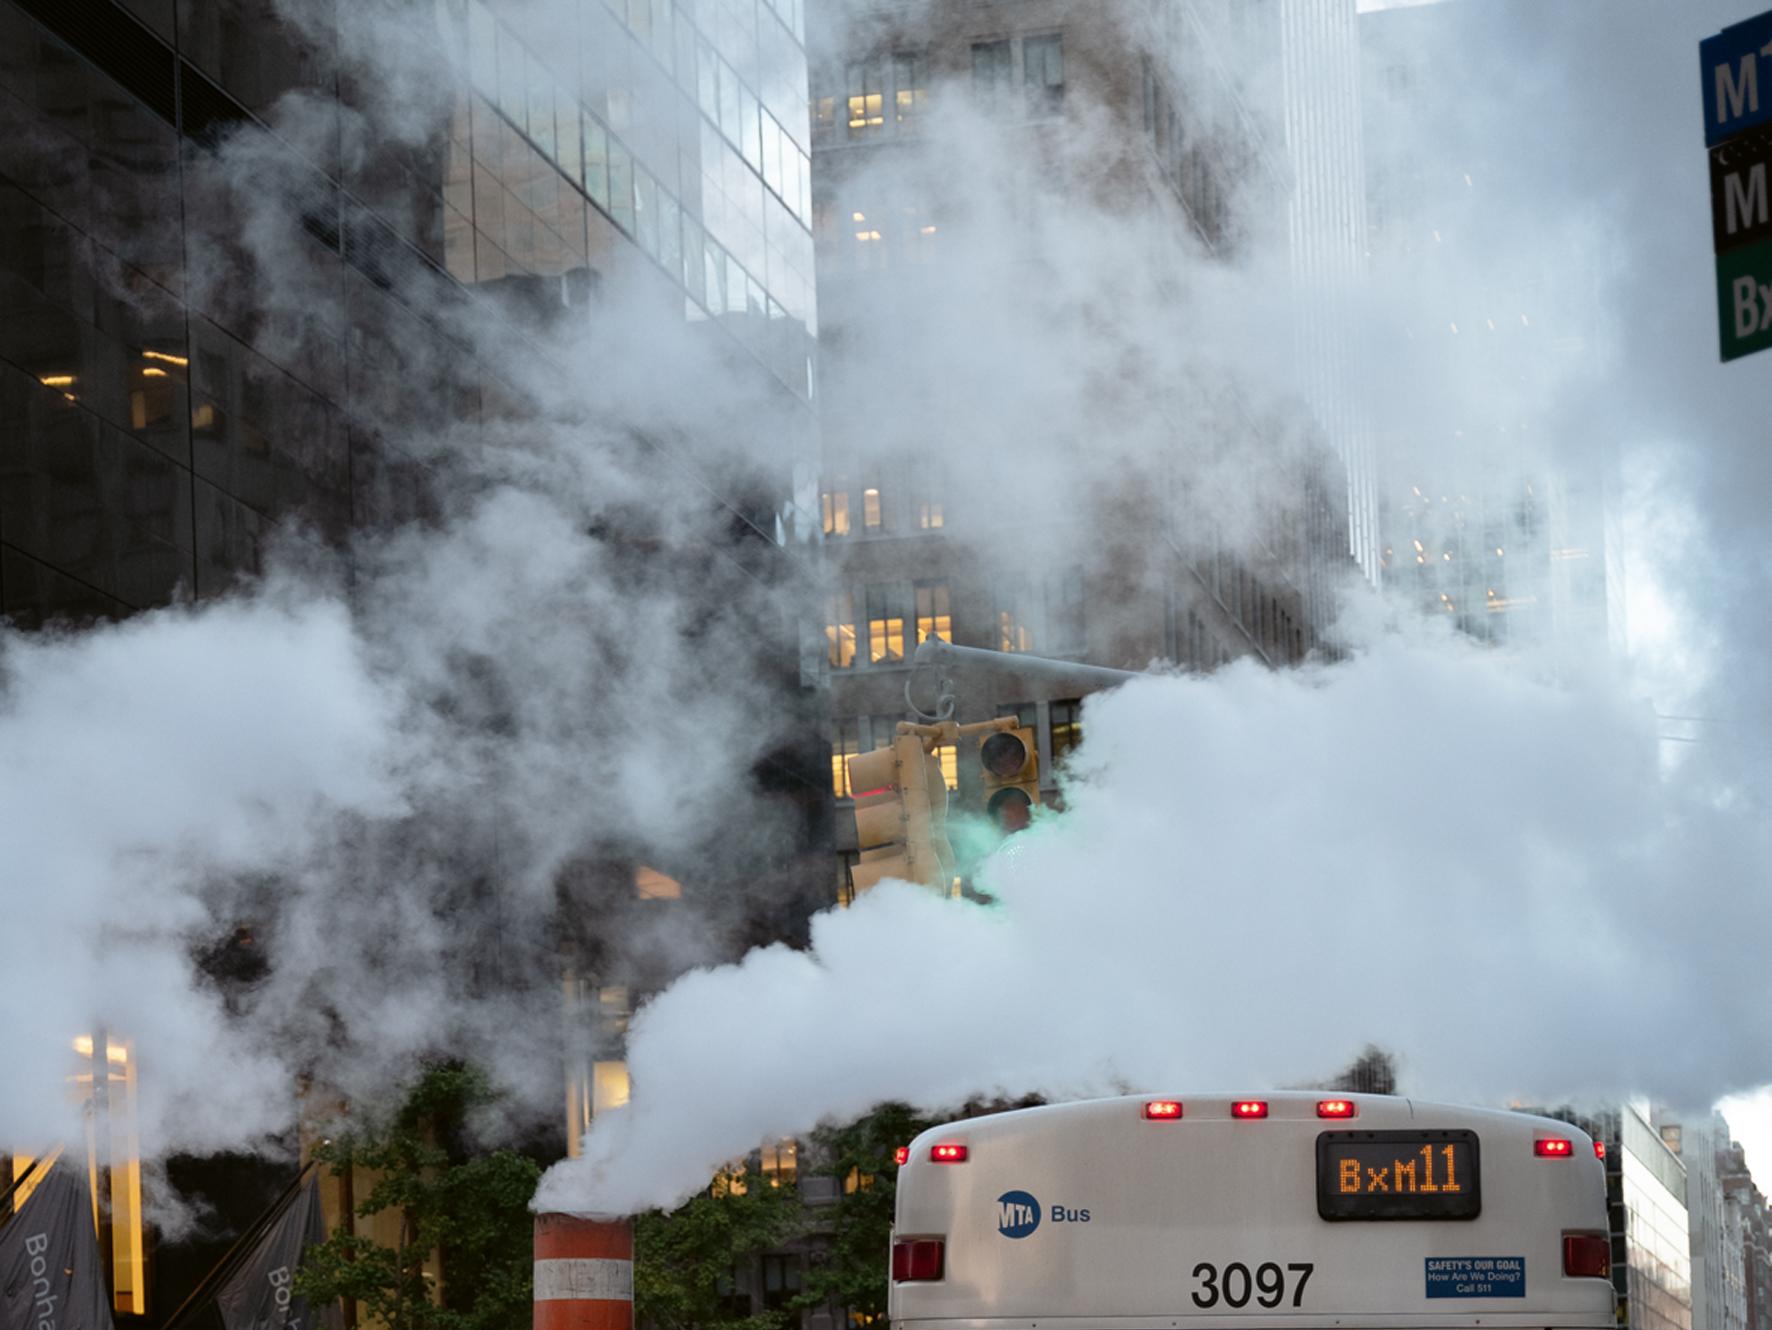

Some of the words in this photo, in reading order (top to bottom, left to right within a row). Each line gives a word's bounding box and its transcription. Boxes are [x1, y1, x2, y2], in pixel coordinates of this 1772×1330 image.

[1715, 40, 1772, 124] M
[1340, 1144, 1461, 1193] BxM11
[997, 1201, 1034, 1229] MTA
[1051, 1204, 1091, 1223] Bus
[1427, 1272, 1450, 1281] How
[1451, 1271, 1468, 1281] Are
[1470, 1272, 1486, 1281] We
[1487, 1271, 1521, 1283] Doing?
[1428, 1260, 1472, 1271] SAFETY'S
[1474, 1260, 1494, 1270] OUR
[1496, 1260, 1521, 1270] GOAL
[1191, 1262, 1314, 1309] 3097
[1456, 1283, 1476, 1293] Call
[1477, 1283, 1492, 1292] 511
